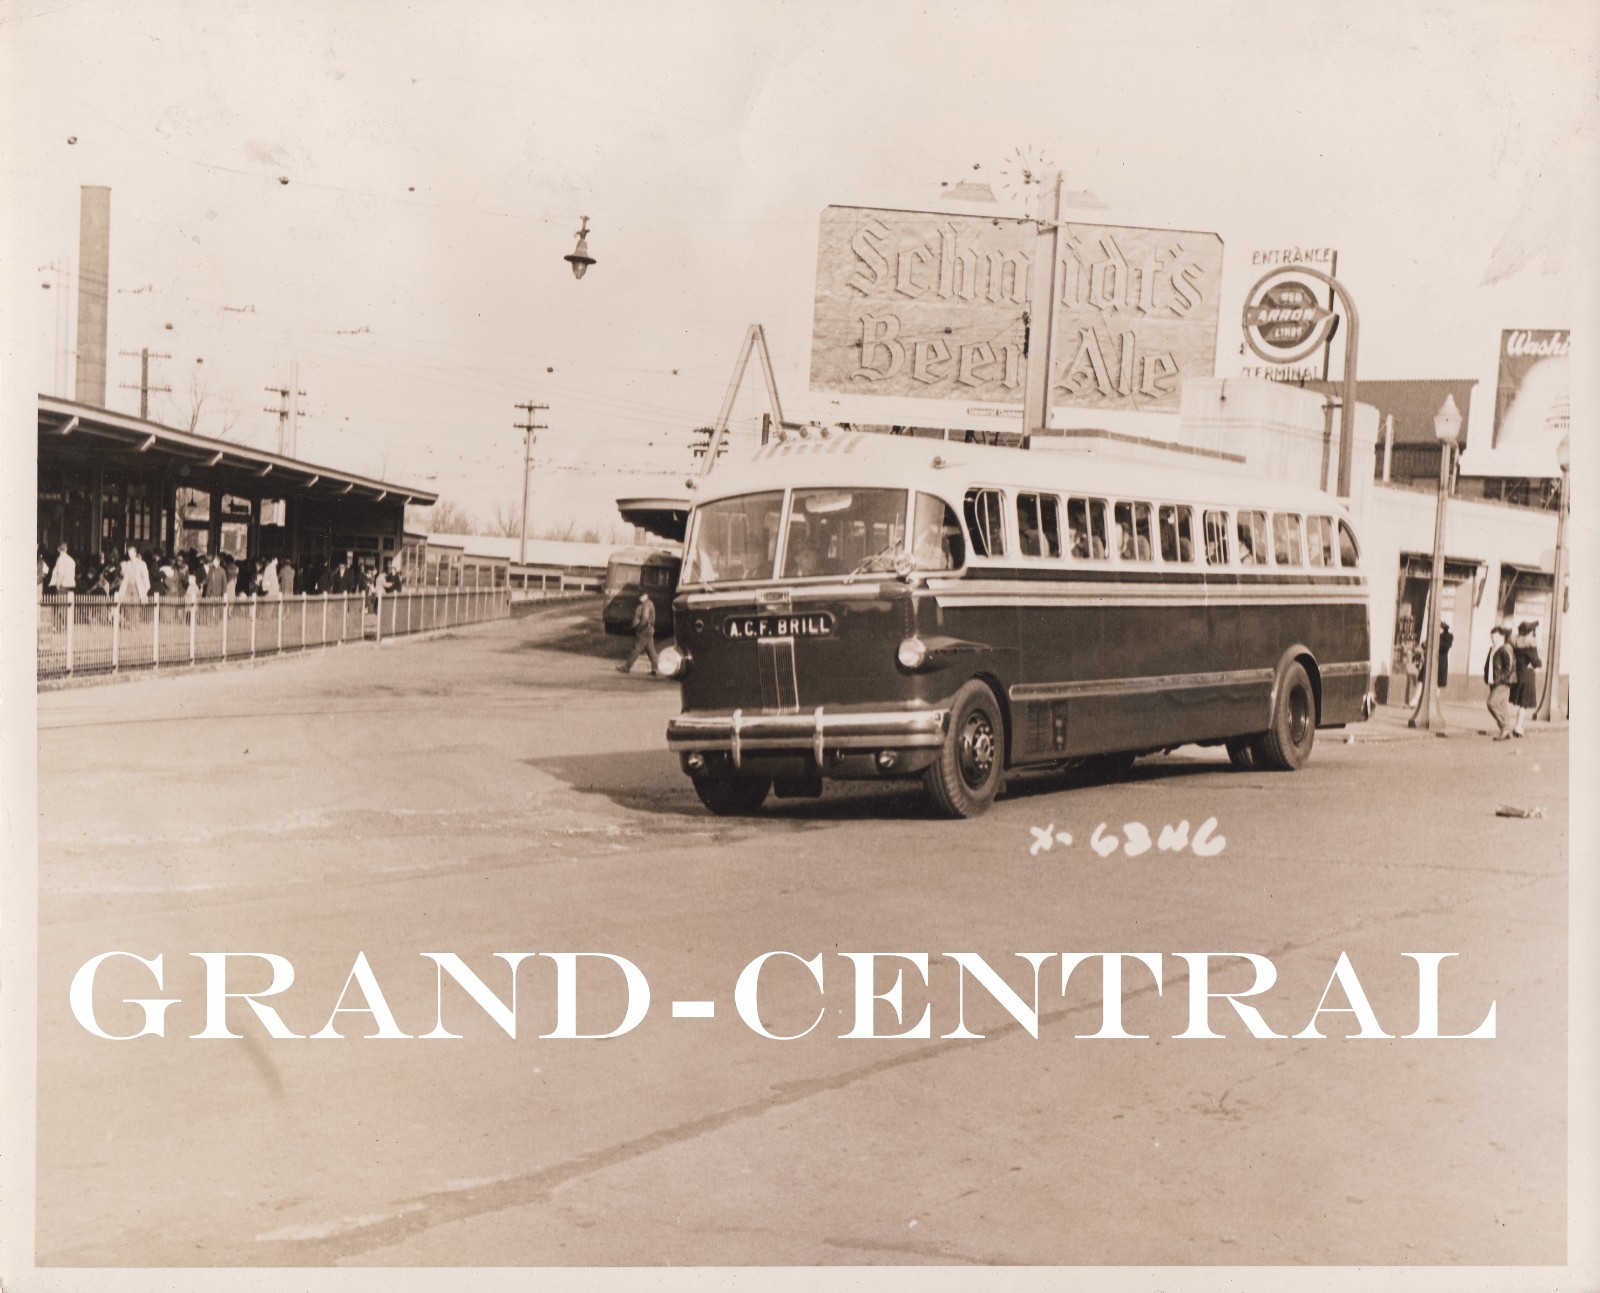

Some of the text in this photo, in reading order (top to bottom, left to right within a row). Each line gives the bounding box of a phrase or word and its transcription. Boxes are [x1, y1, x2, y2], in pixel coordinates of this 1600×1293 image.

[1251, 247, 1333, 265] ENTRANCE
[1257, 308, 1316, 322] ARROW
[1053, 326, 1181, 398] Ale
[1241, 365, 1322, 383] TERMINAL
[729, 616, 830, 638] A.C.F. BRILL
